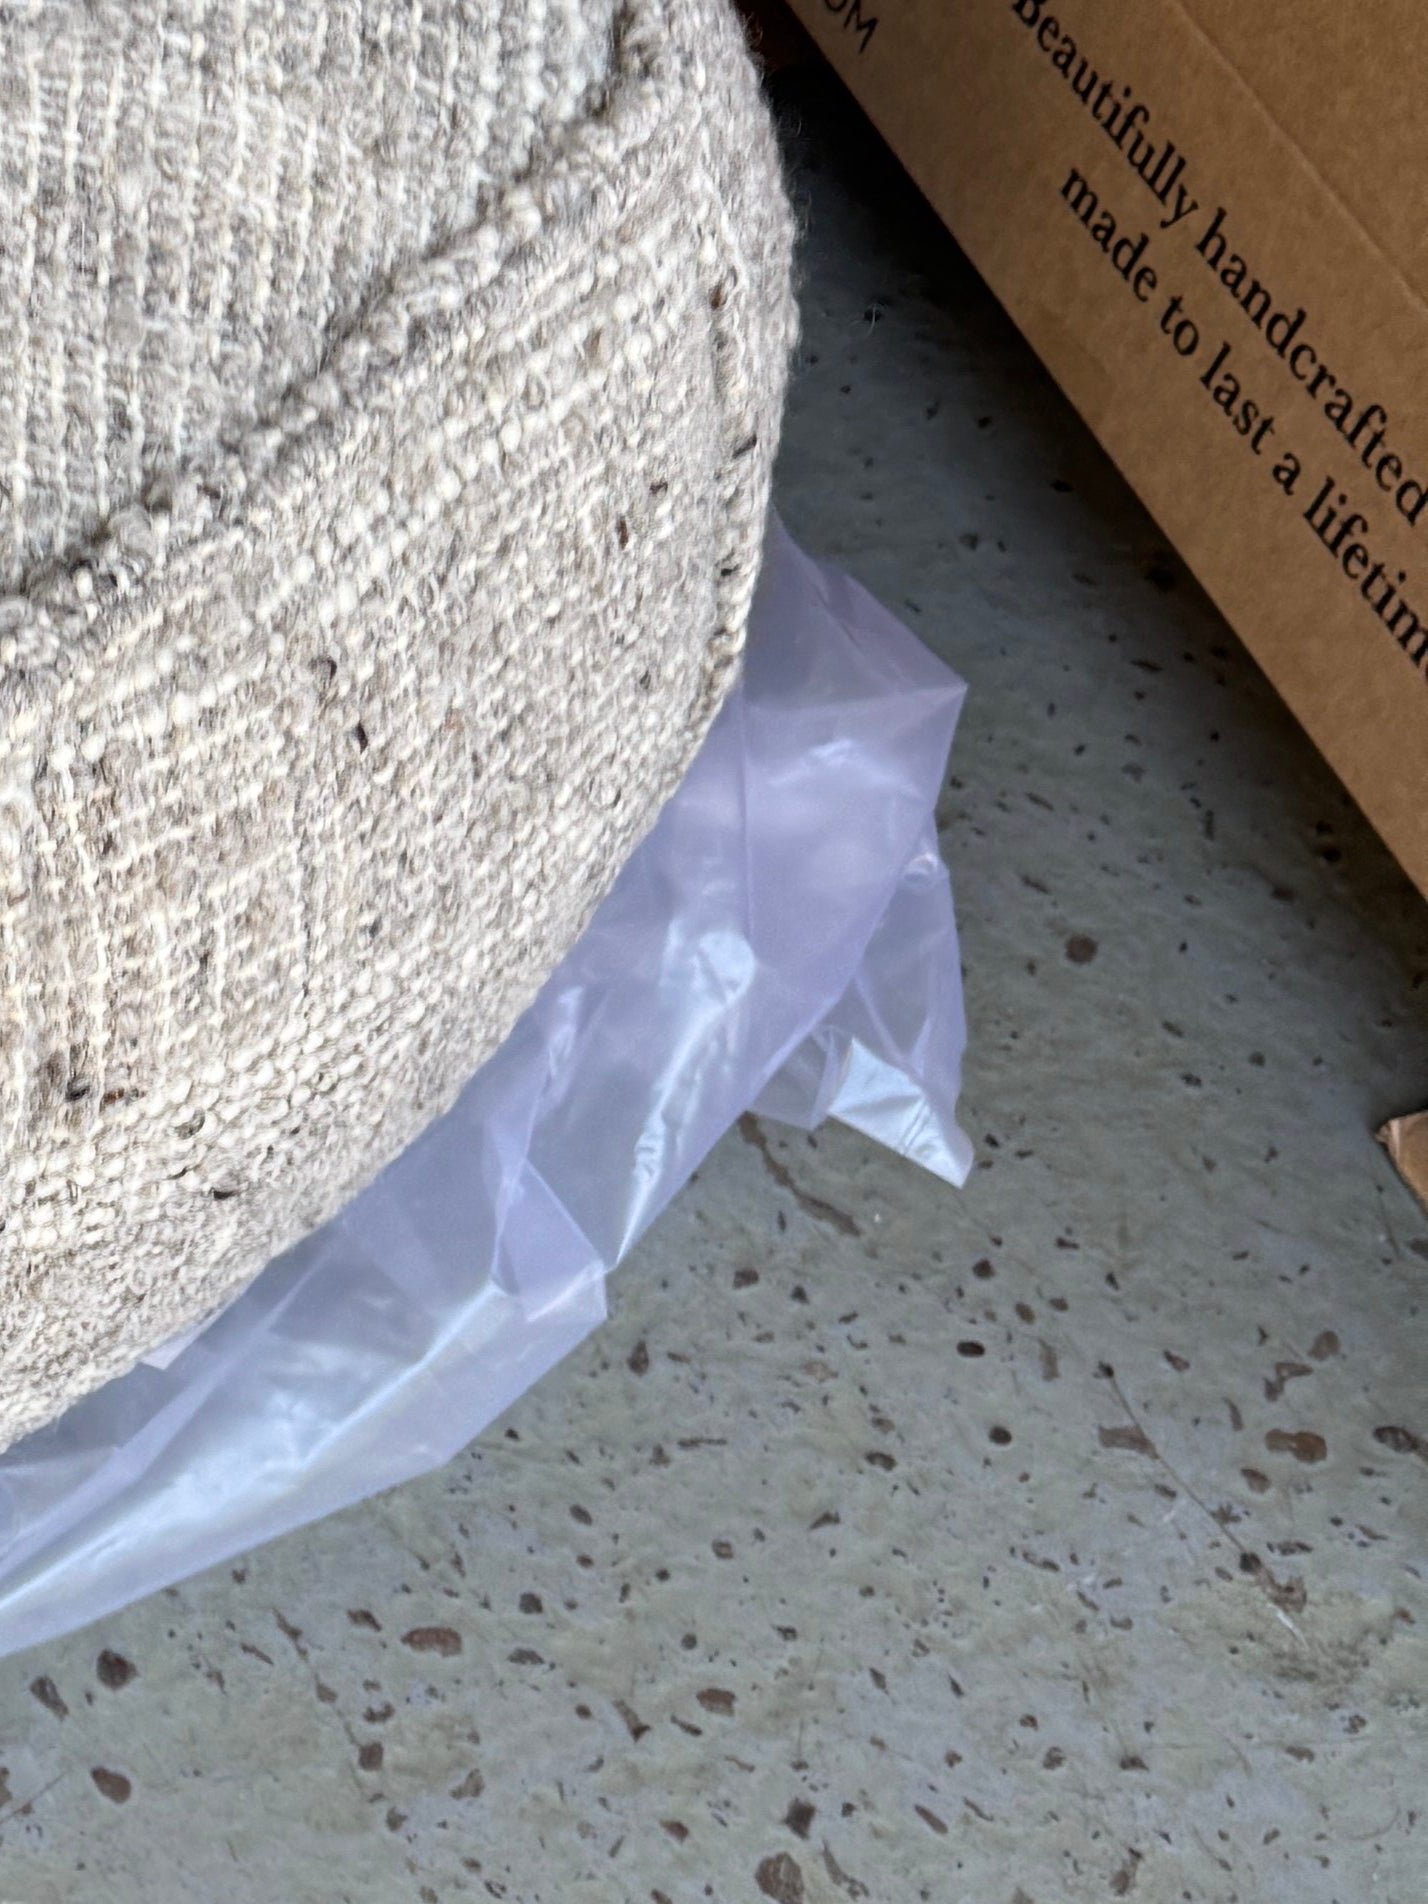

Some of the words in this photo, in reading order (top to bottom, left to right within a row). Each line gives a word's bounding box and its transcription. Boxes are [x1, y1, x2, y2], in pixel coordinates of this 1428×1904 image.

[1060, 168, 1157, 303] made
[1159, 296, 1200, 357] to
[1200, 342, 1275, 455] last
[1272, 452, 1301, 496] a
[1302, 476, 1428, 684] lifetim
[1195, 207, 1428, 527] handcrafted
